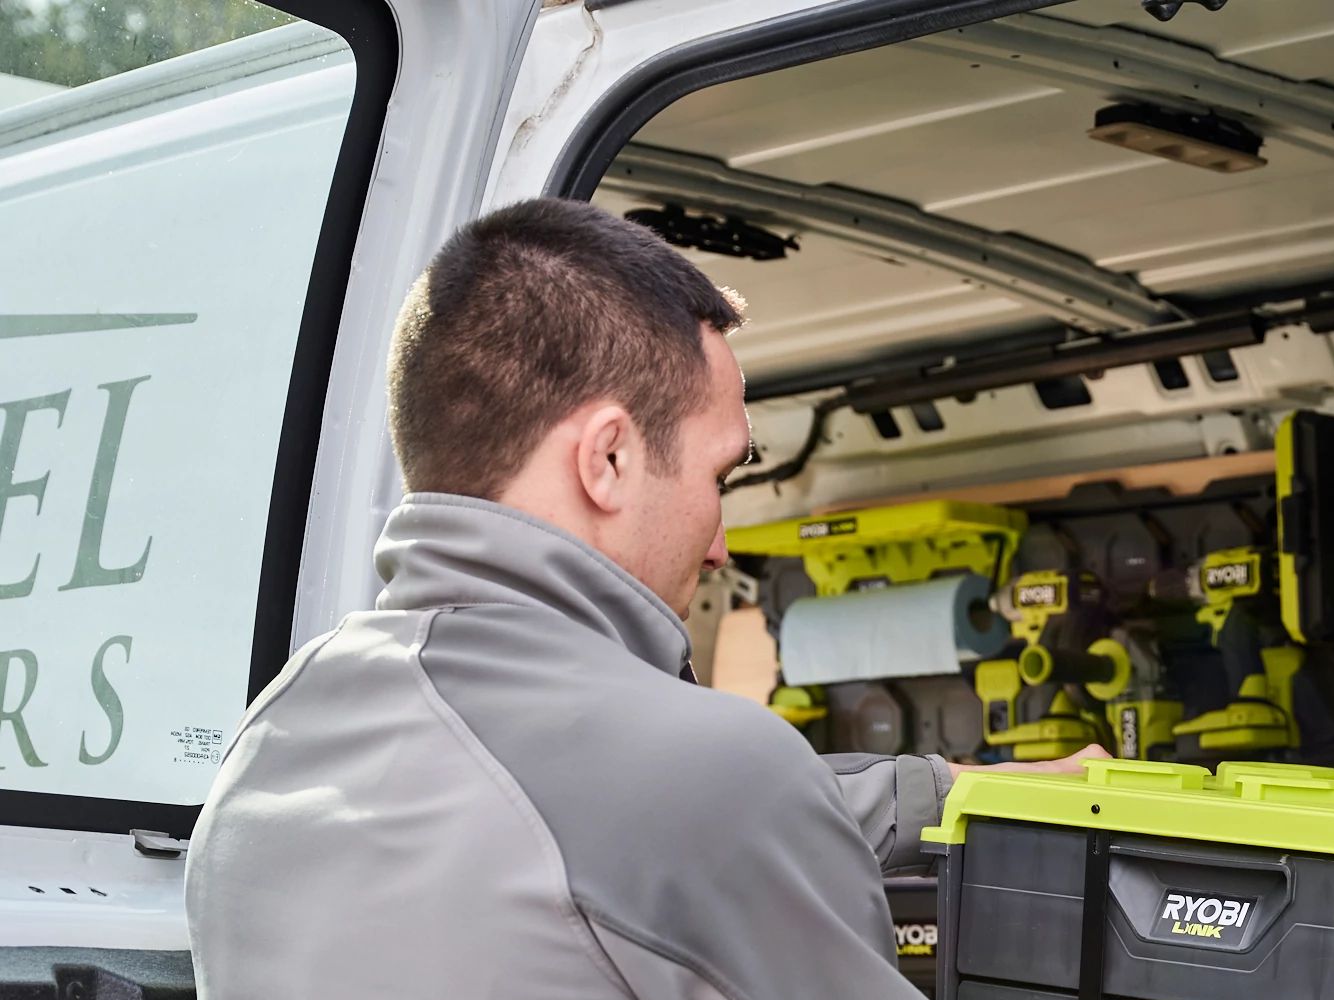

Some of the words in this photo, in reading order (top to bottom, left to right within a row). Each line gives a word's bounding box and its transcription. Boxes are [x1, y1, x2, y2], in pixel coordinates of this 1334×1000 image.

[1206, 564, 1248, 585] RYOBI
[1162, 894, 1250, 928] RYOBI
[895, 924, 938, 945] YOB
[1171, 922, 1224, 939] LINK
